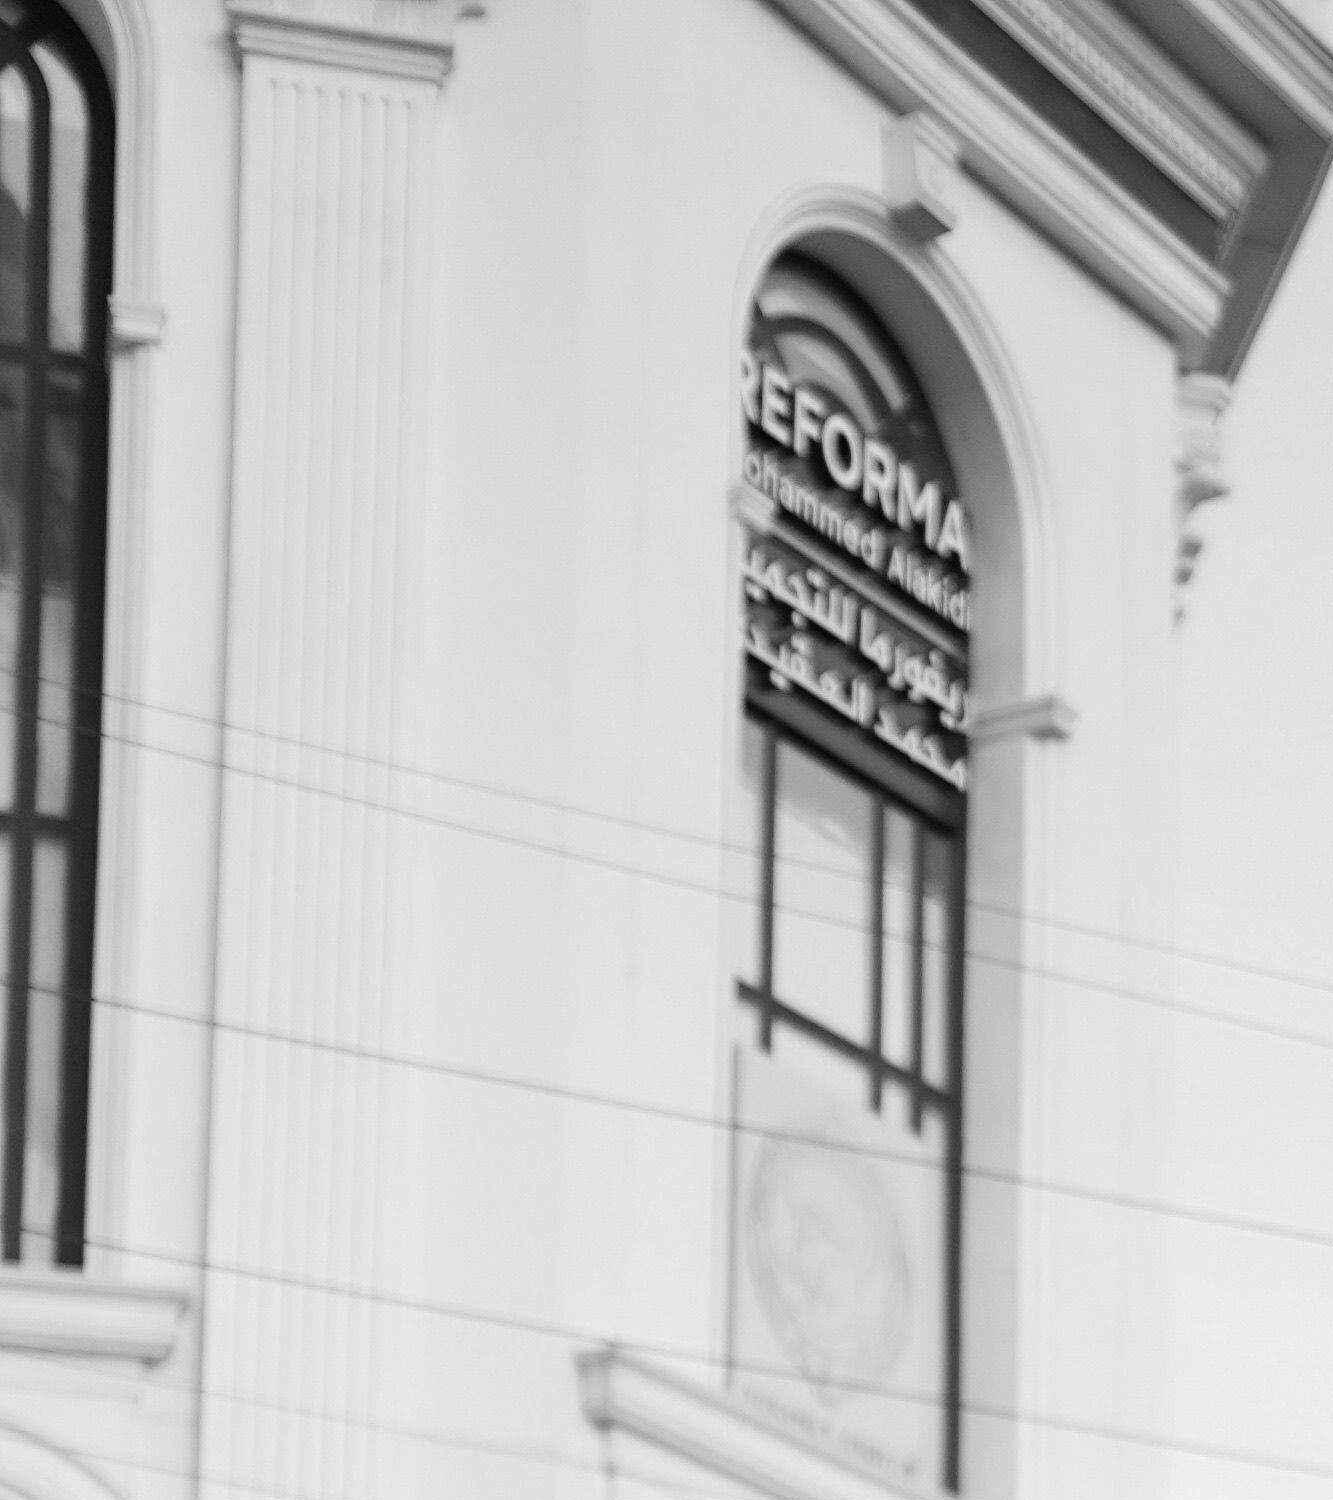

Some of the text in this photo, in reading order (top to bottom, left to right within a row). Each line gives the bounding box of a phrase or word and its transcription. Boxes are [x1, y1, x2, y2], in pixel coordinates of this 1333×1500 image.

[739, 346, 970, 572] REFORMA
[743, 450, 886, 570] ohammed
[740, 547, 858, 648] للتجمي
[740, 622, 874, 730] العقيد
